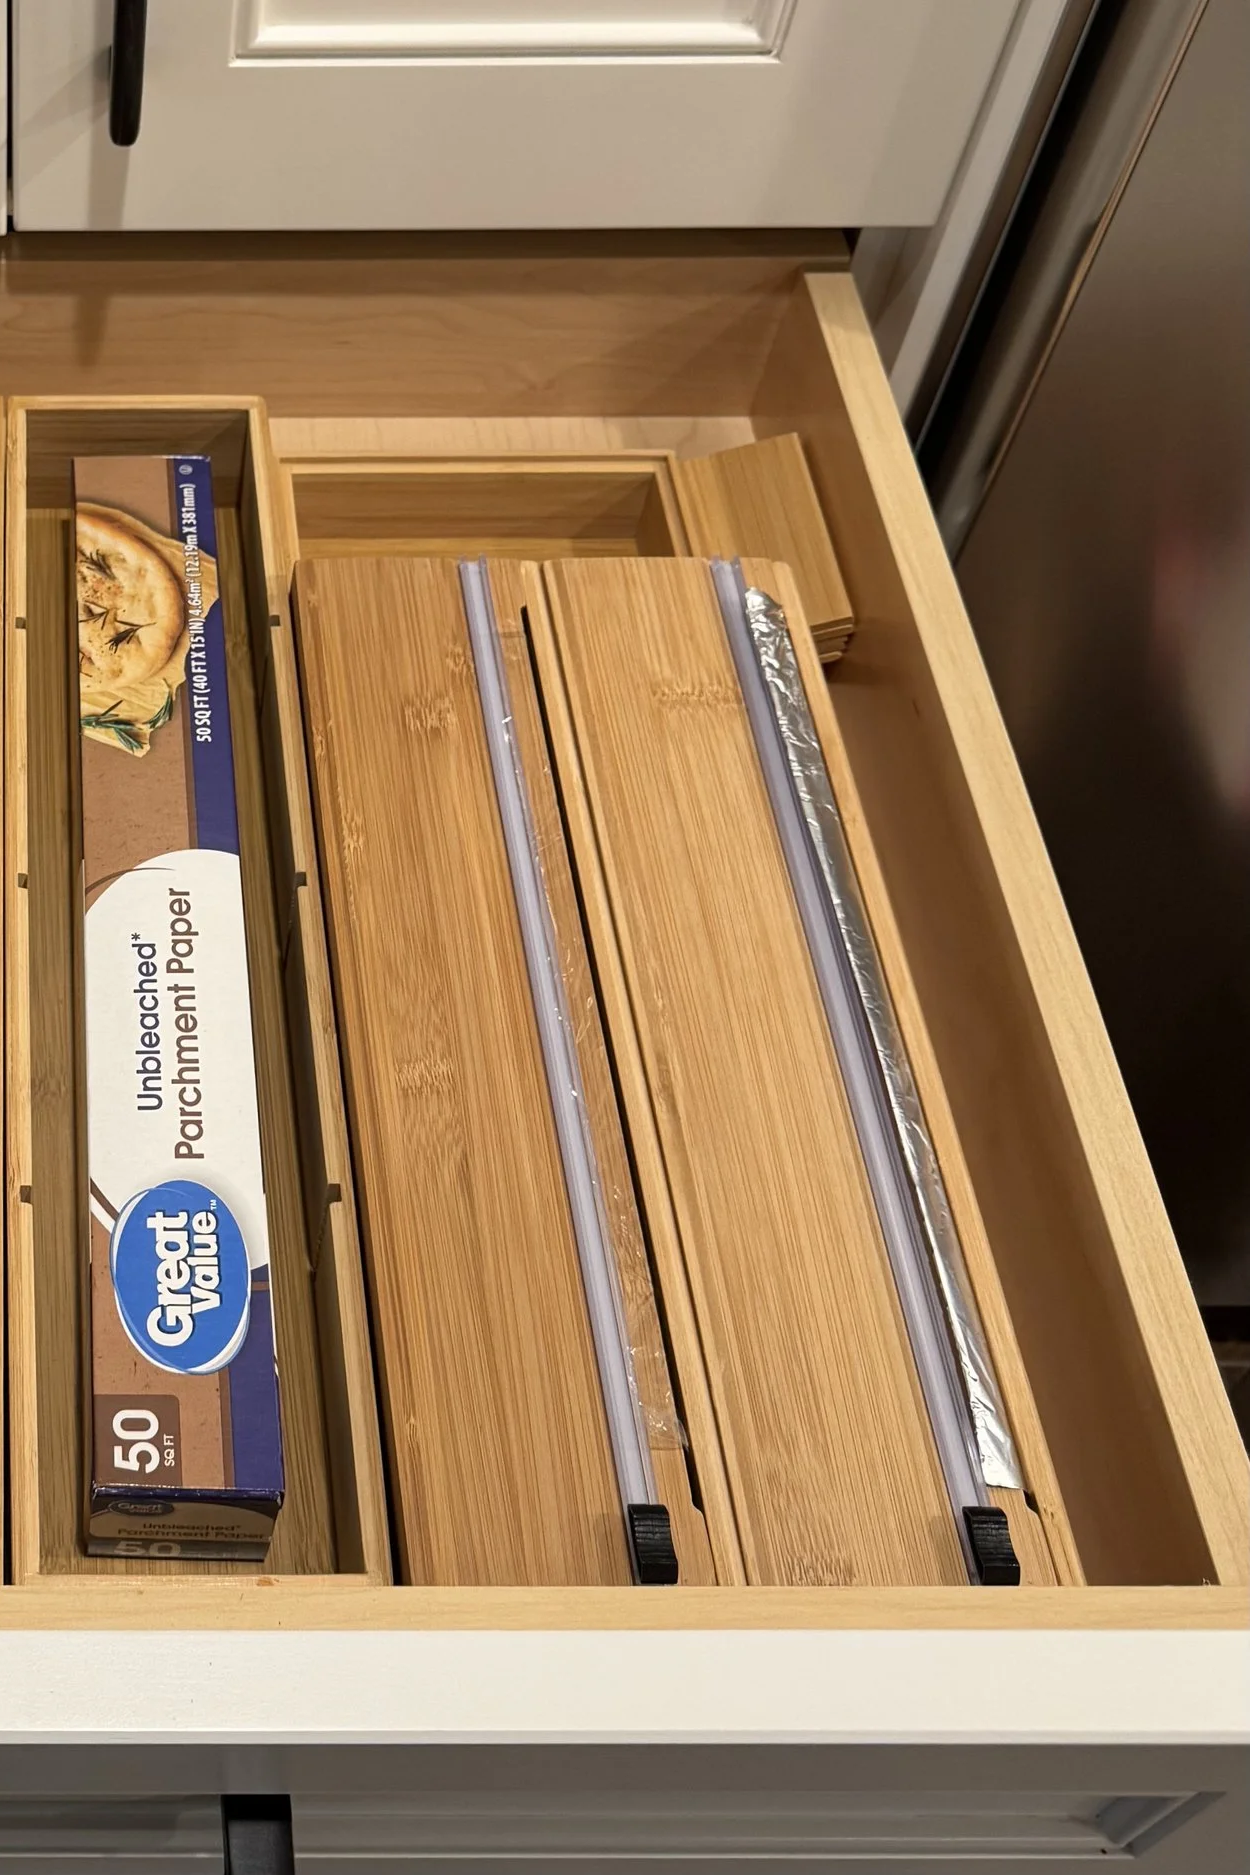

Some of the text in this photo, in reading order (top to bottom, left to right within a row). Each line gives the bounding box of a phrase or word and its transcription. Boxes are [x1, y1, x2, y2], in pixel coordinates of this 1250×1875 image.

[178, 484, 197, 525] 381mm)
[182, 526, 197, 534] X
[184, 535, 201, 577] (12.19m
[189, 619, 206, 635] IN)
[190, 636, 205, 648] 15
[191, 651, 206, 659] X
[191, 661, 207, 673] FT
[192, 675, 210, 693] (40
[194, 696, 209, 708] FT
[195, 710, 211, 725] SQ
[197, 728, 212, 742] 50
[166, 887, 205, 1160] Parchment Paper
[190, 1210, 222, 1314] Value
[146, 1210, 195, 1348] Great
[112, 1408, 160, 1474] 50
[163, 1434, 176, 1467] SQ FT
[117, 1528, 264, 1540] Parchment Paper
[113, 1540, 181, 1558] 50
